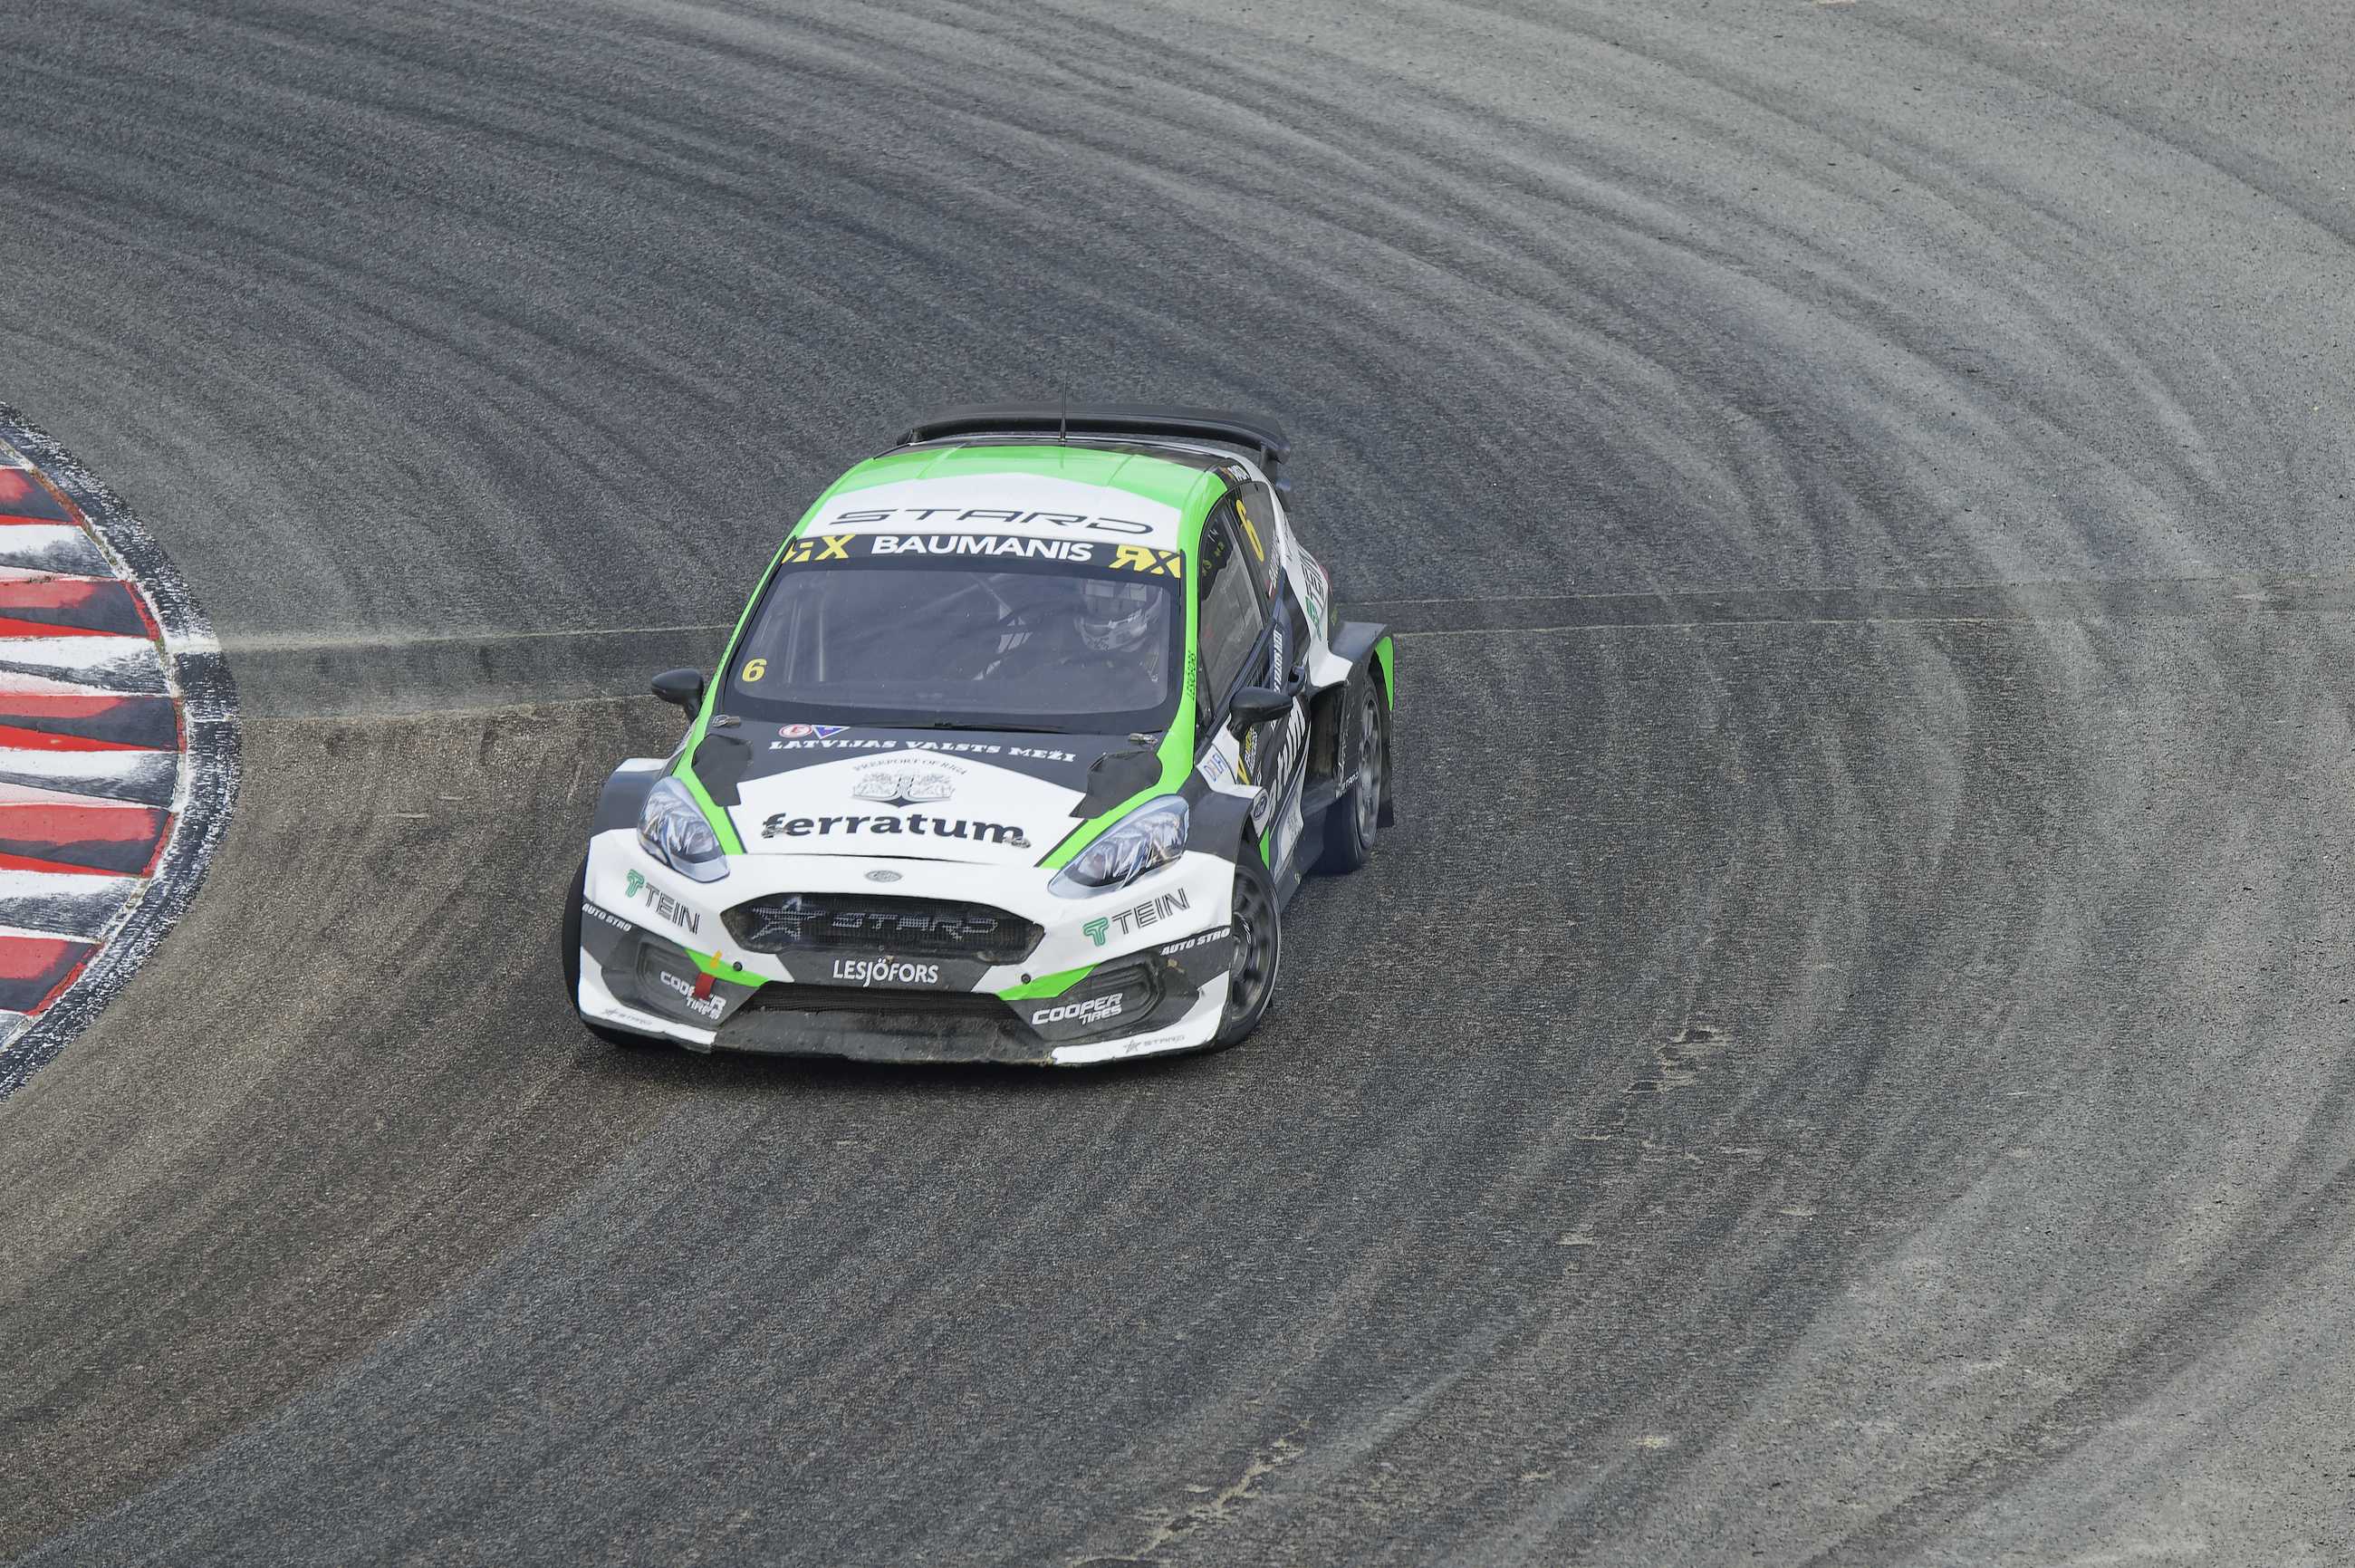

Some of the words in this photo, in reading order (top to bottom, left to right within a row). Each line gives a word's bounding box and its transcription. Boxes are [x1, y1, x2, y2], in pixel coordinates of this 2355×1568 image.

[830, 508, 1154, 535] STARD
[1236, 499, 1264, 563] 6
[871, 535, 1093, 561] BAUMANIS
[742, 659, 767, 682] 6
[769, 739, 897, 751] LATVIJAS
[906, 740, 1001, 754] VALSTS
[1007, 746, 1077, 763] MEŽI
[761, 813, 1027, 846] ferratum
[582, 902, 606, 921] AUTO
[645, 881, 701, 935] TEIN
[1111, 888, 1191, 935] TEIN
[832, 911, 998, 942] STARD
[1159, 938, 1196, 957] AUTO
[832, 958, 939, 987] LESJÖFORS
[660, 970, 726, 1012] COOR
[1032, 993, 1123, 1025] COOPER
[1078, 1005, 1123, 1026] TIRES
